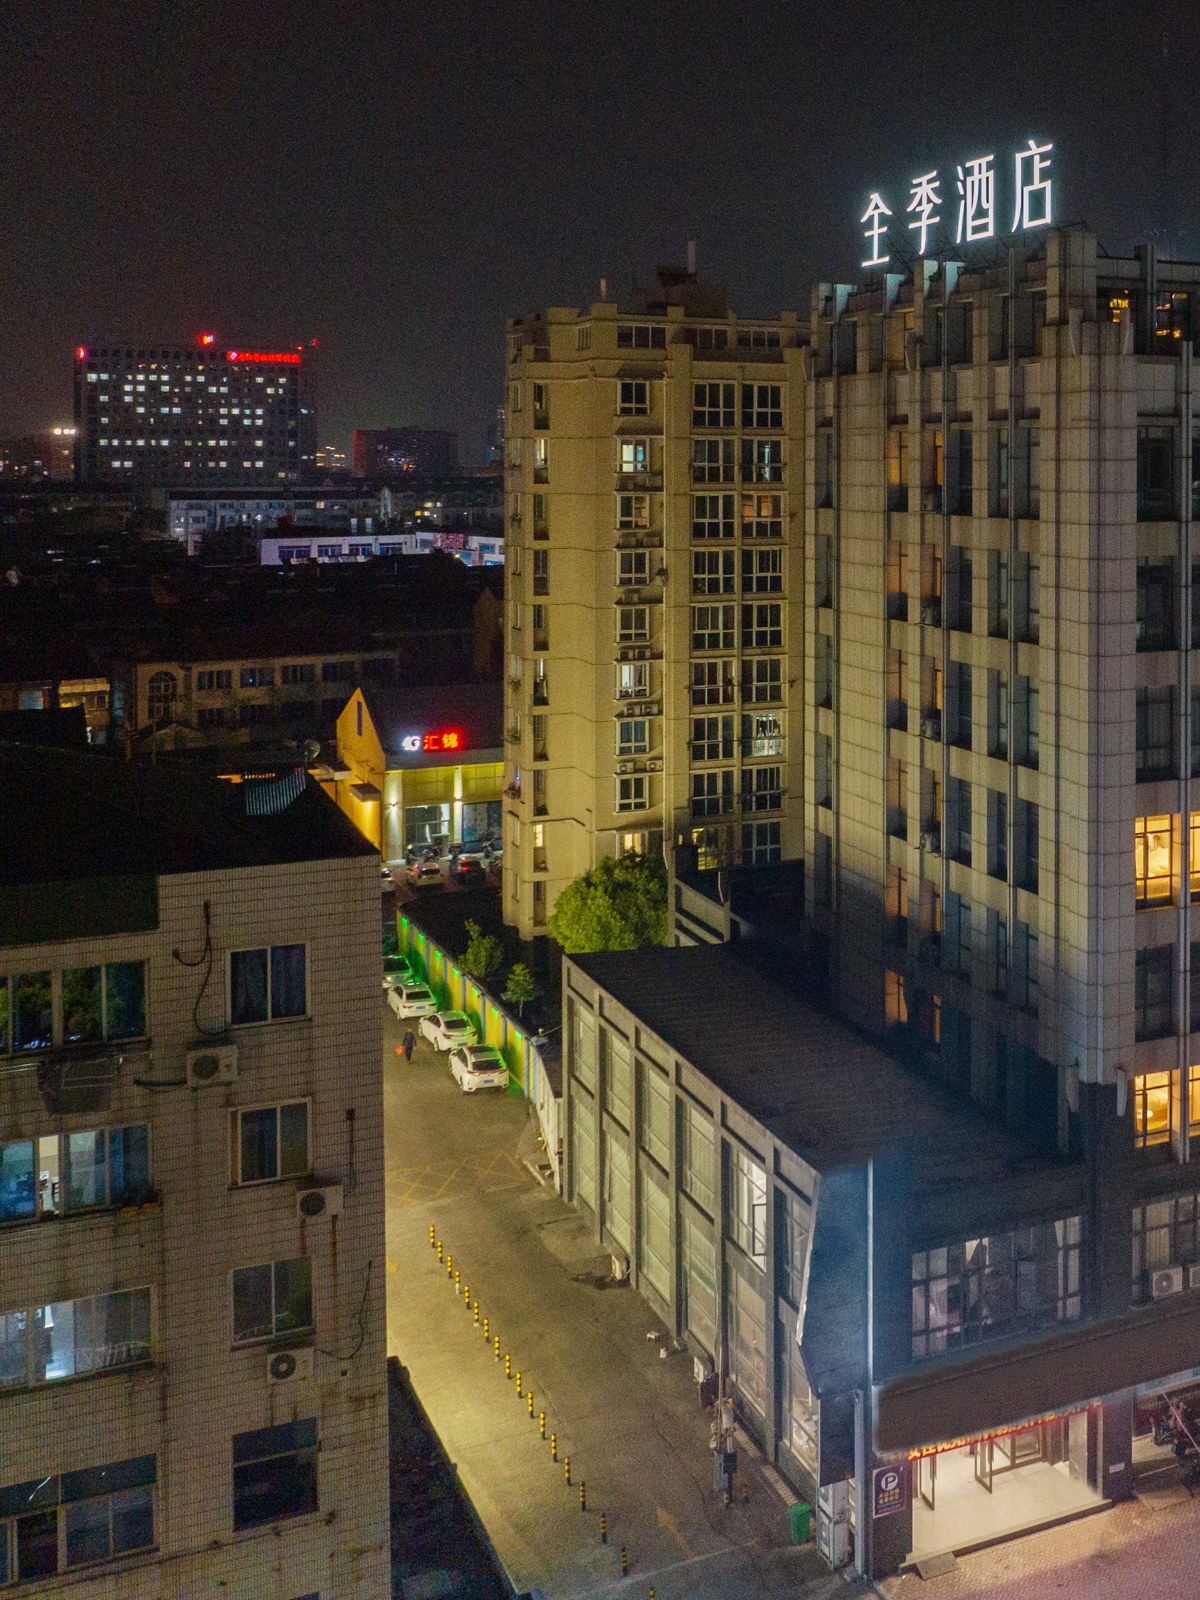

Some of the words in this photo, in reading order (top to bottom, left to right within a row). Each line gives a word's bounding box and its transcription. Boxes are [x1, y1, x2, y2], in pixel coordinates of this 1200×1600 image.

[860, 139, 1053, 267] 全季酒店
[883, 1474, 897, 1489] P
